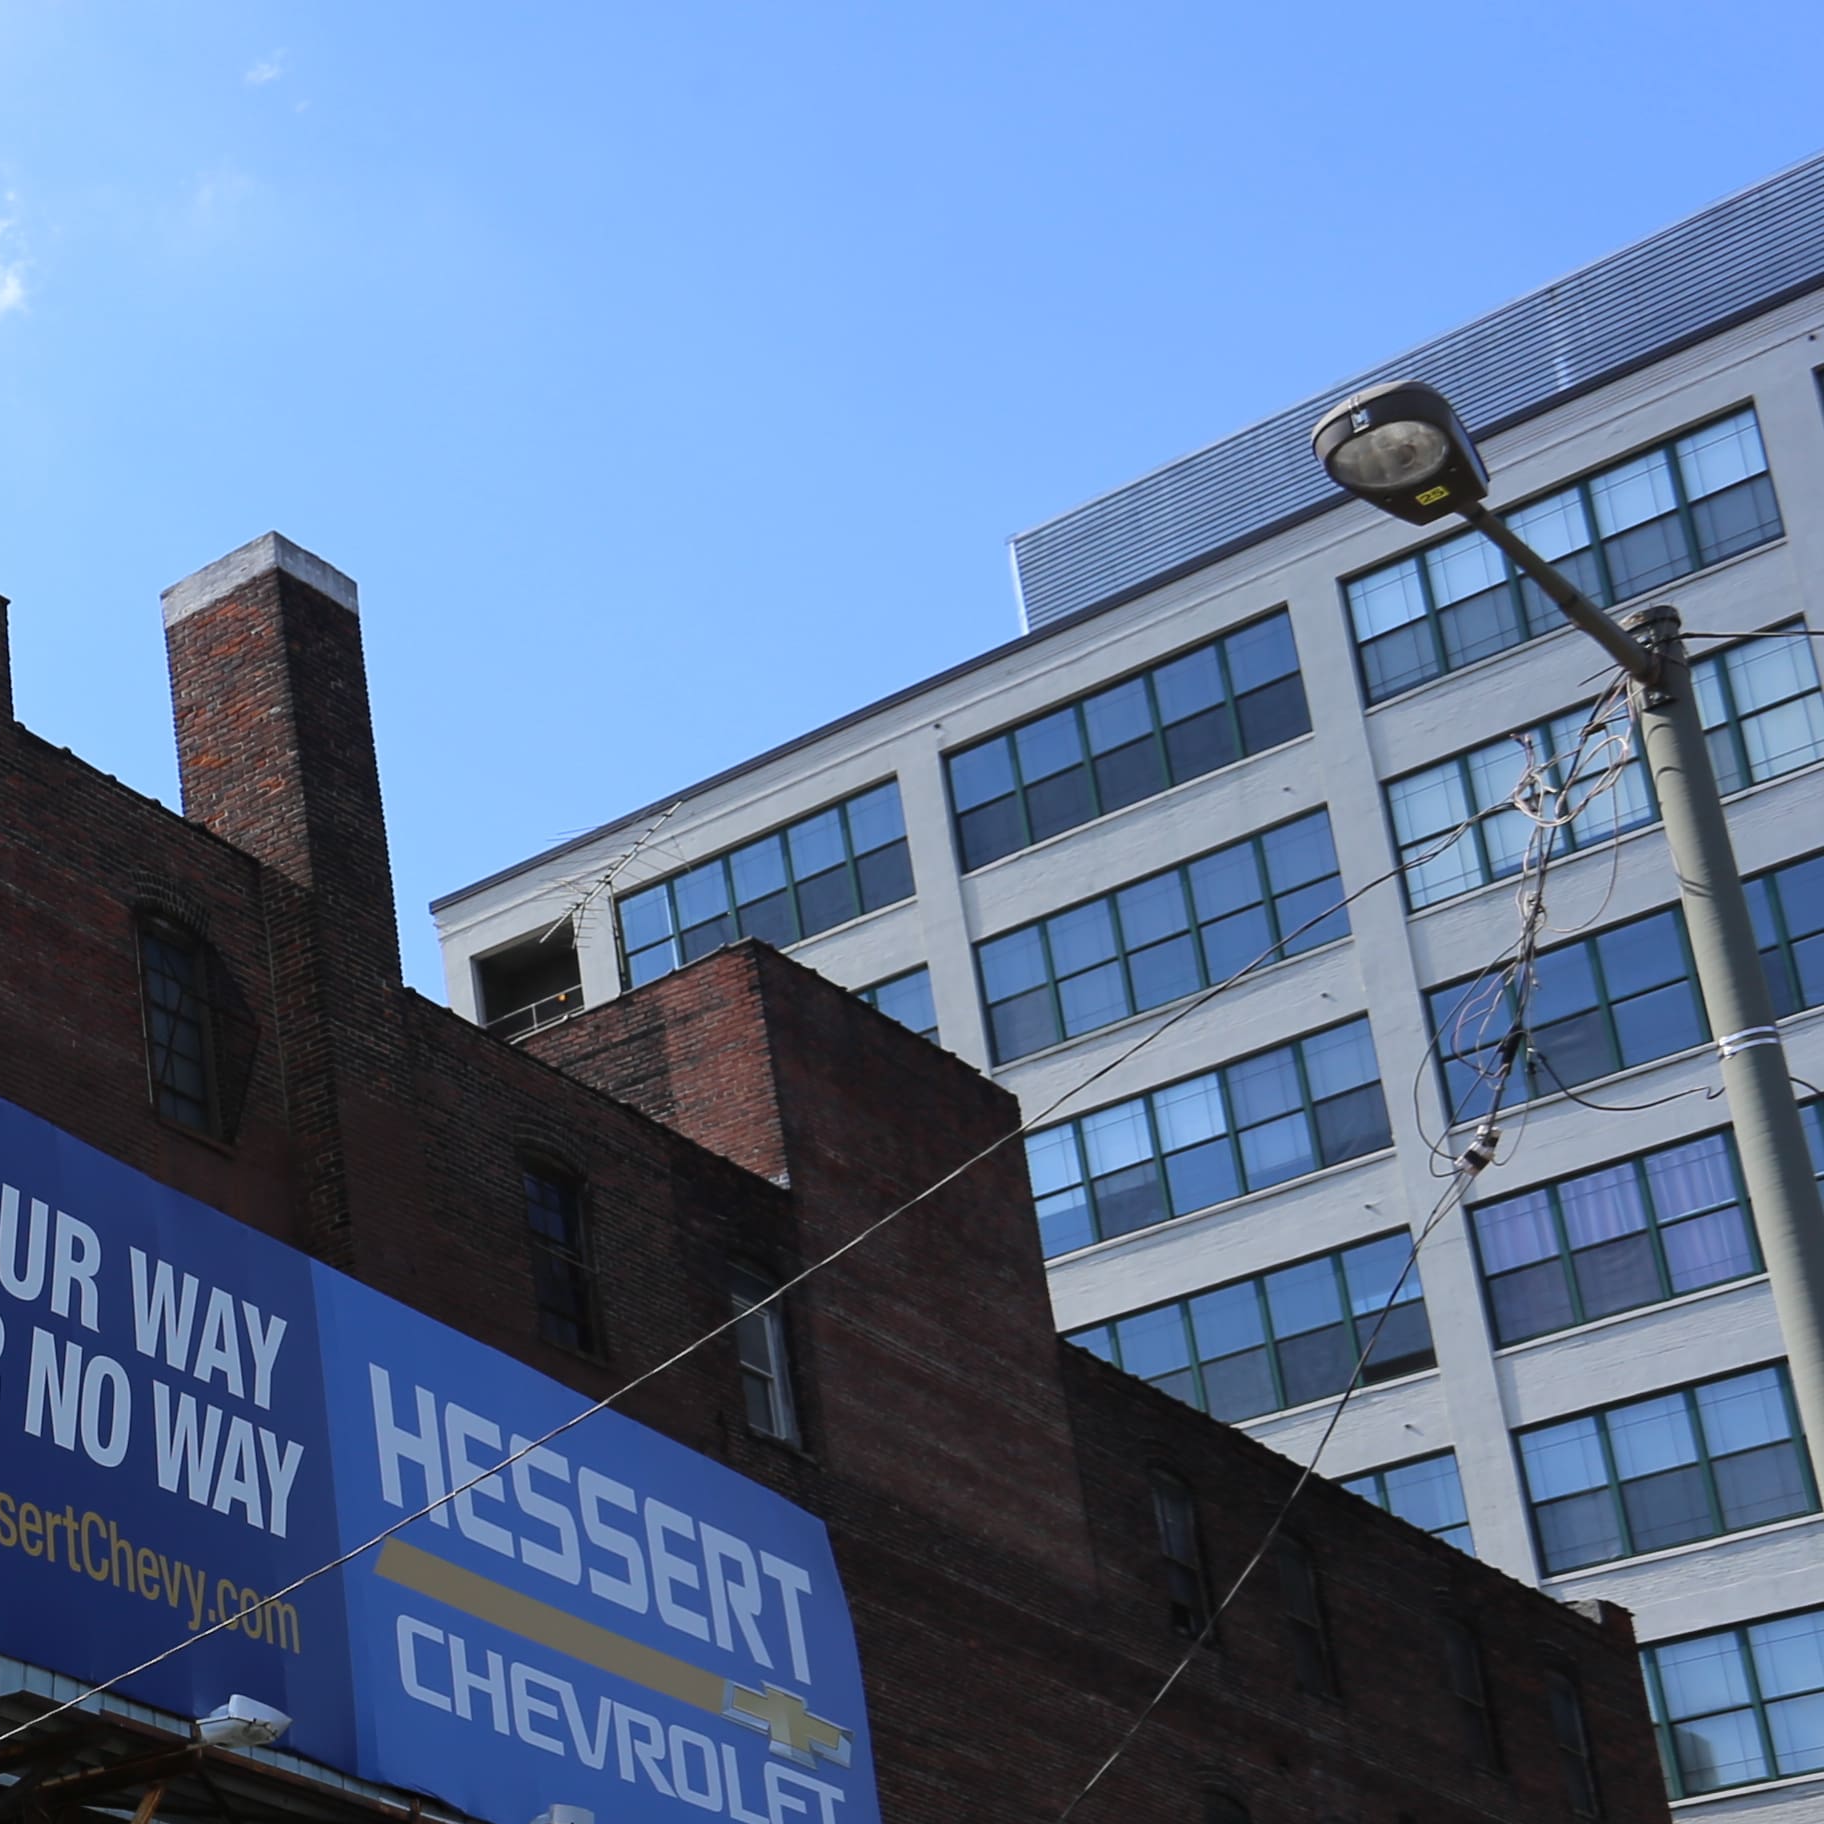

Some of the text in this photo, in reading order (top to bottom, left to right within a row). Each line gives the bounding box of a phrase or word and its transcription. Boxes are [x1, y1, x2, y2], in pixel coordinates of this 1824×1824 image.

[24, 1325, 133, 1468] NO
[153, 1379, 305, 1539] WAY
[131, 1246, 288, 1411] WAY
[368, 1361, 813, 1686] HESSERT
